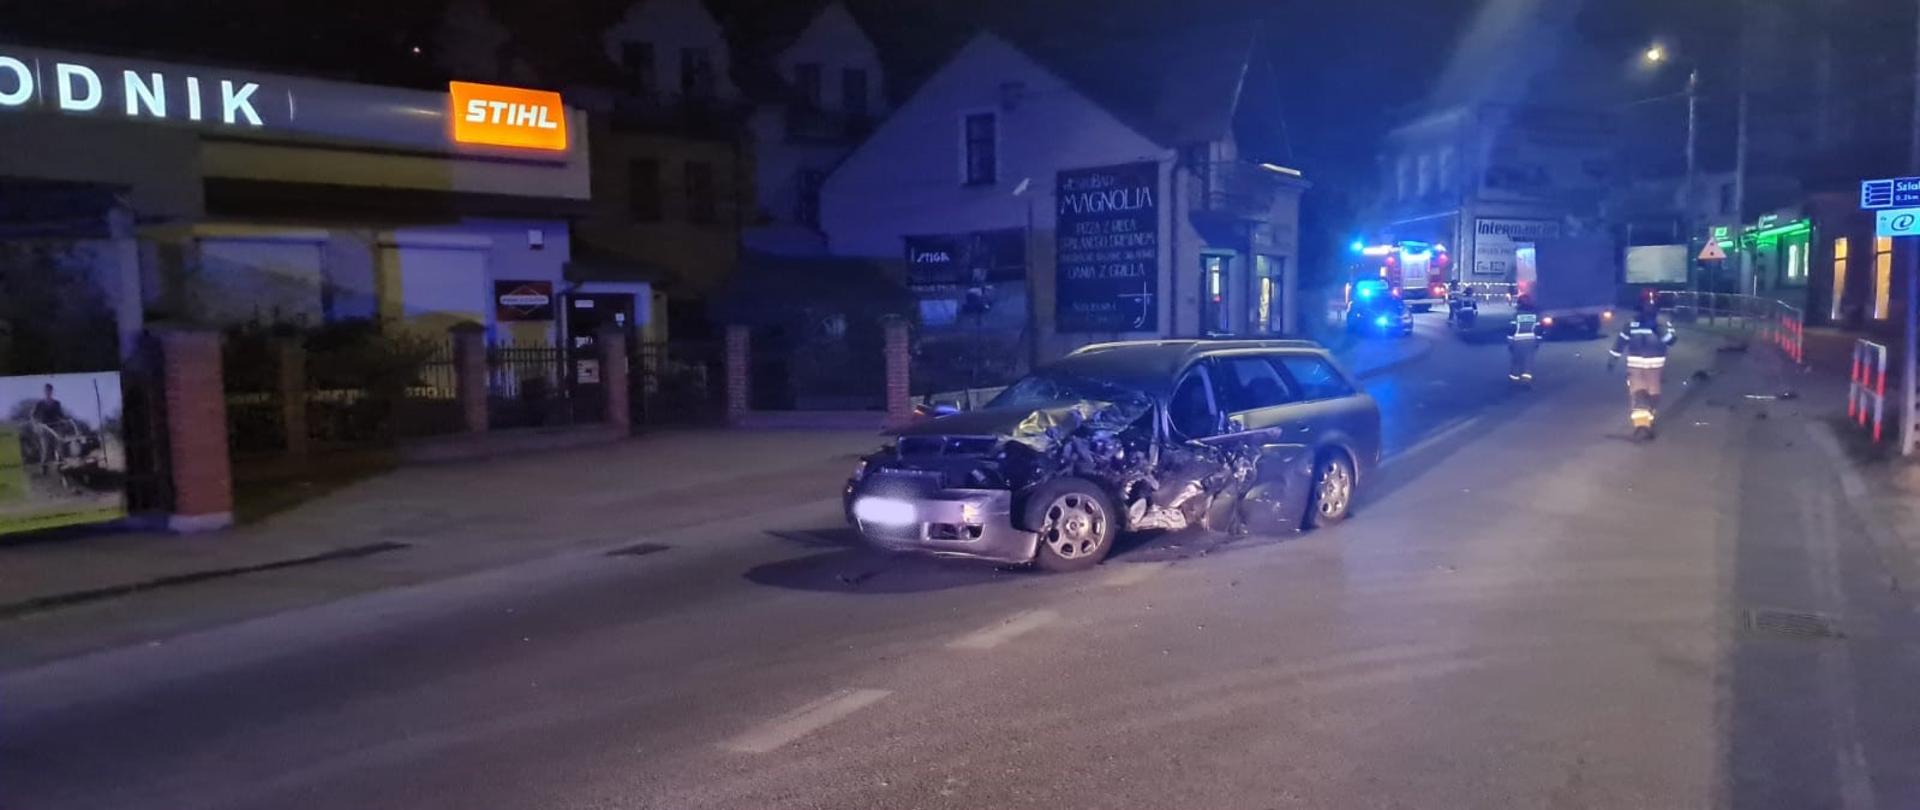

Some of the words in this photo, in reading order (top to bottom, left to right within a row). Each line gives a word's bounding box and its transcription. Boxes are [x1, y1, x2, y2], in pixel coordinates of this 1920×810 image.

[466, 99, 557, 129] STIHL
[1061, 186, 1153, 215] MAGNOLIA
[1896, 181, 1920, 192] Szla
